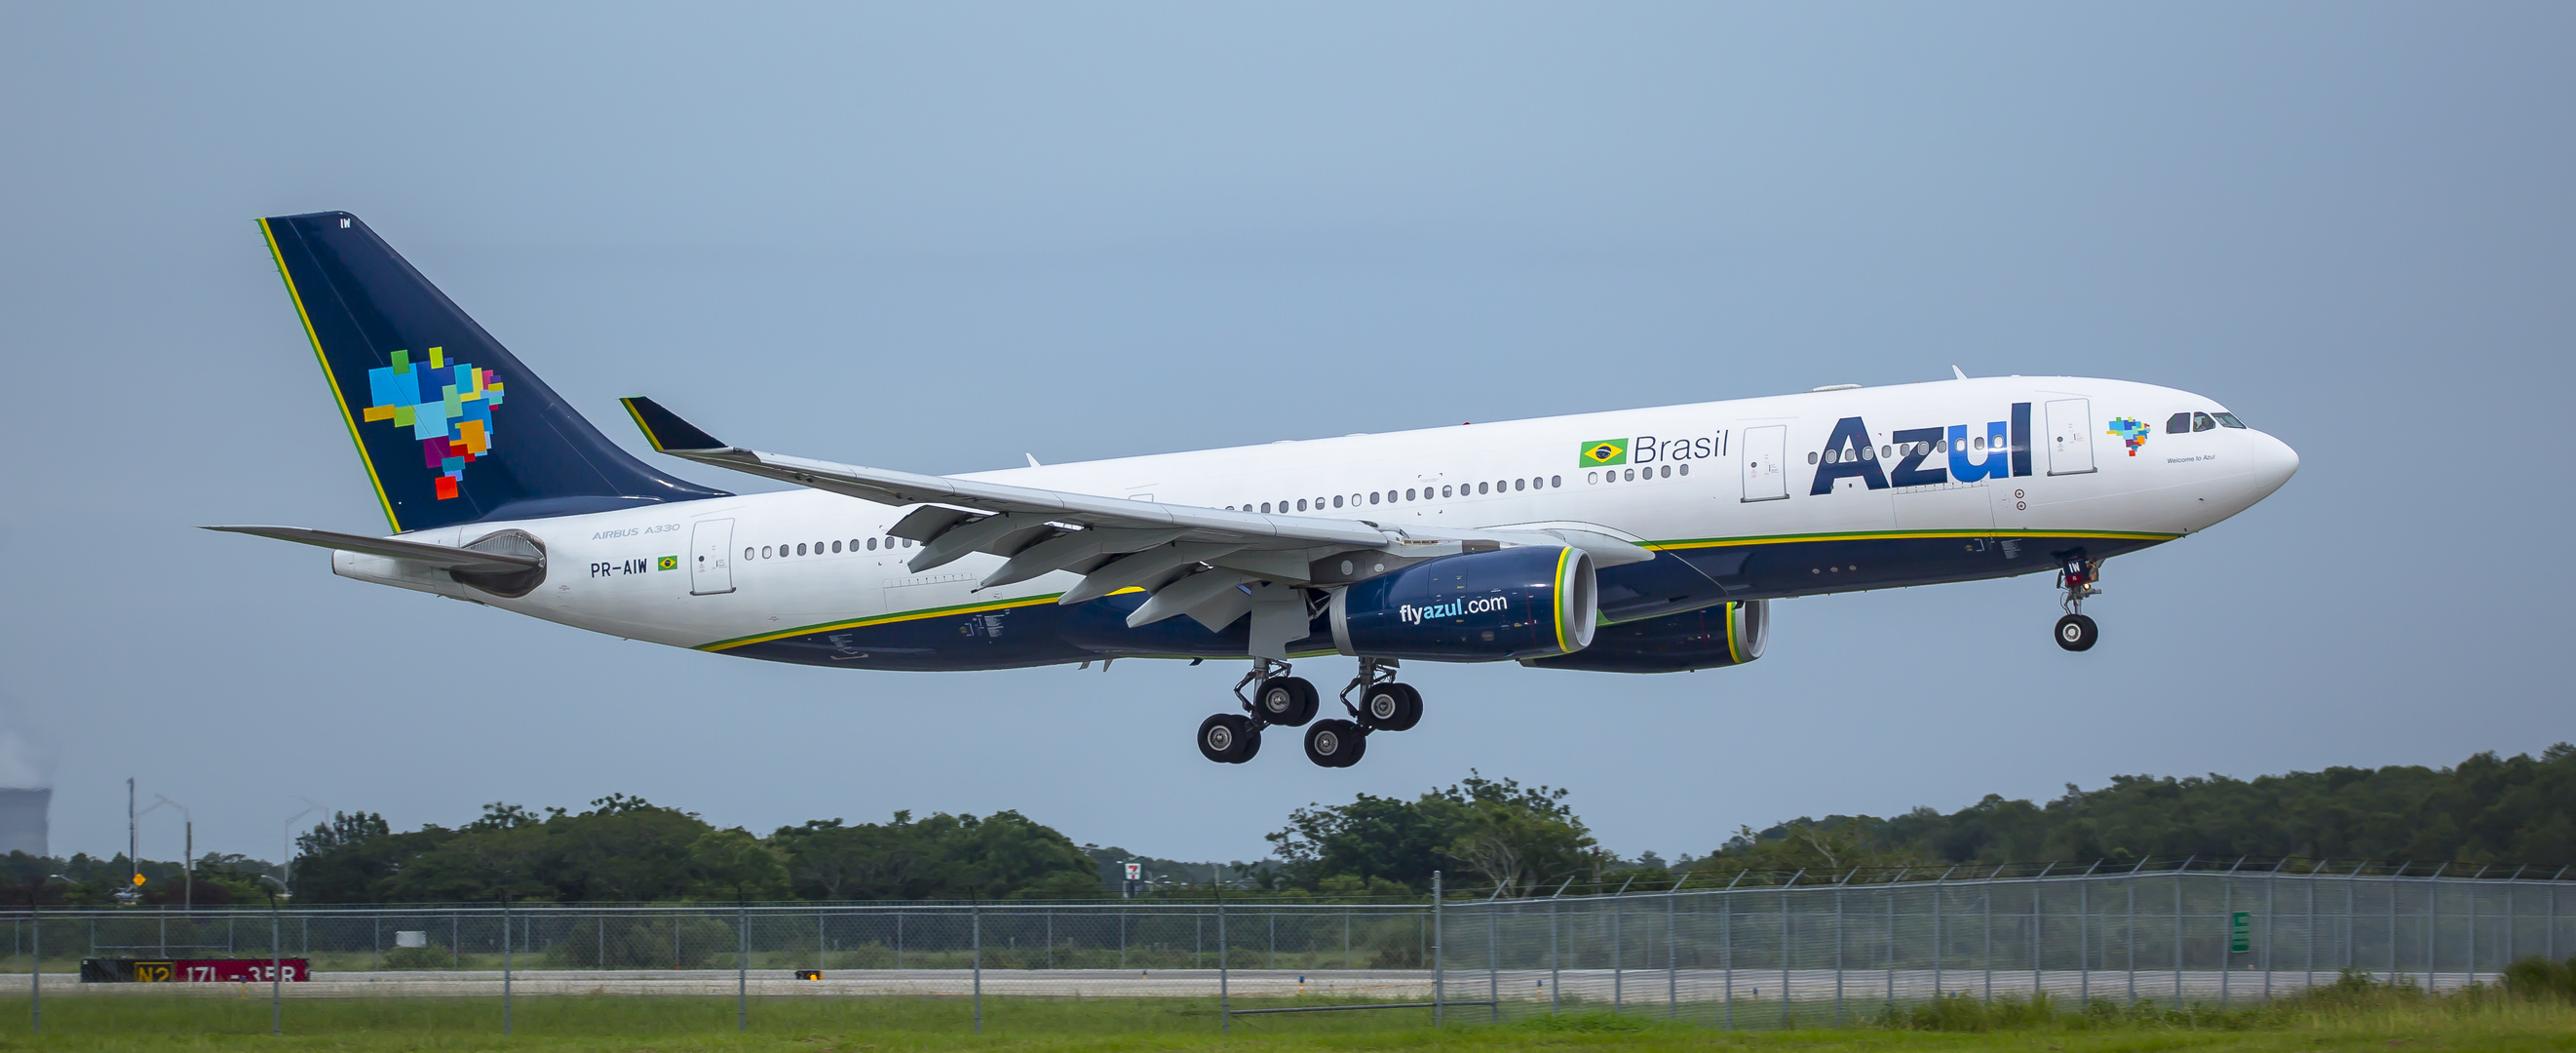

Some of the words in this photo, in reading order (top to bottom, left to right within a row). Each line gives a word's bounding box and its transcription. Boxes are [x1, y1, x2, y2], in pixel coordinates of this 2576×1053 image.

[340, 218, 351, 229] IW
[1634, 429, 1729, 464] Brasil
[1809, 402, 2033, 496] Azul
[592, 527, 639, 541] AIRBUS
[643, 524, 681, 535] A330
[591, 558, 647, 578] PR-AIW
[2068, 562, 2081, 573] IW
[1399, 595, 1509, 626] flyazul.com
[138, 966, 170, 982] N2
